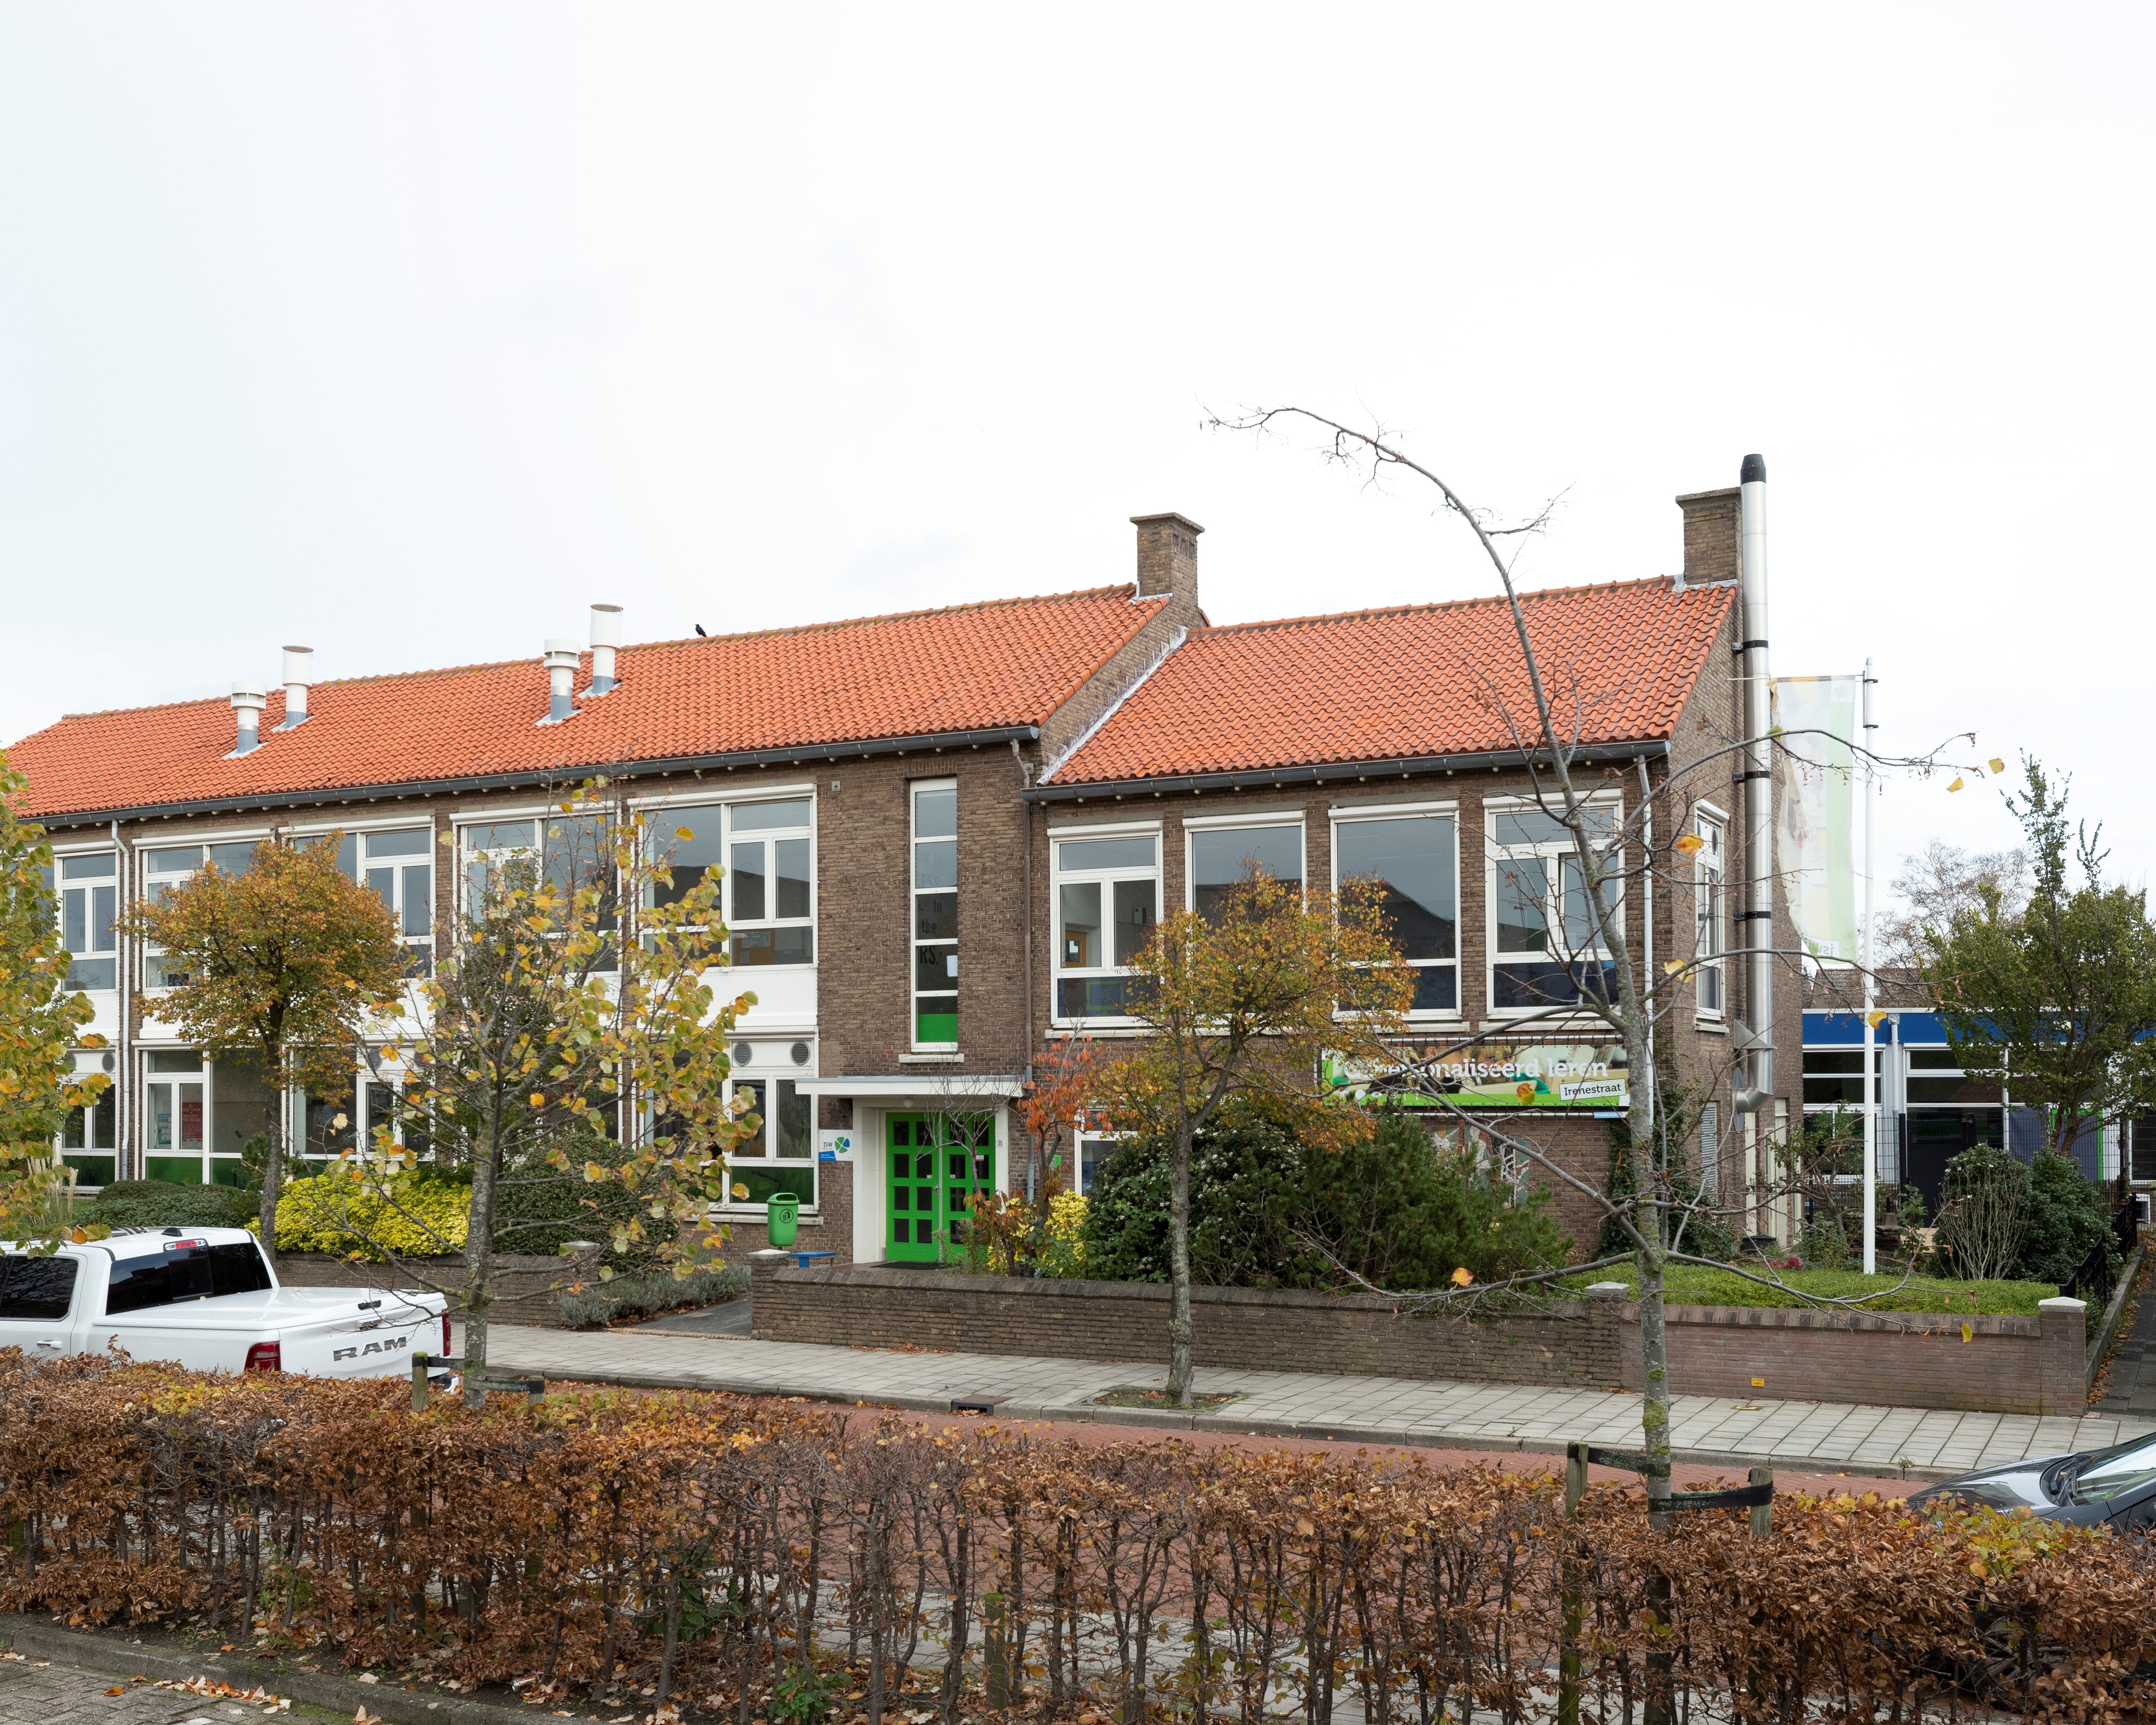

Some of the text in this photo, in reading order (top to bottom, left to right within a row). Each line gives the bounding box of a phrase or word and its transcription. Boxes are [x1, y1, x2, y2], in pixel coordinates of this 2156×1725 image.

[921, 918, 936, 934] the
[1547, 1058, 1608, 1077] leren
[1564, 1083, 1621, 1096] Irenestraat
[333, 1336, 406, 1361] RAM
